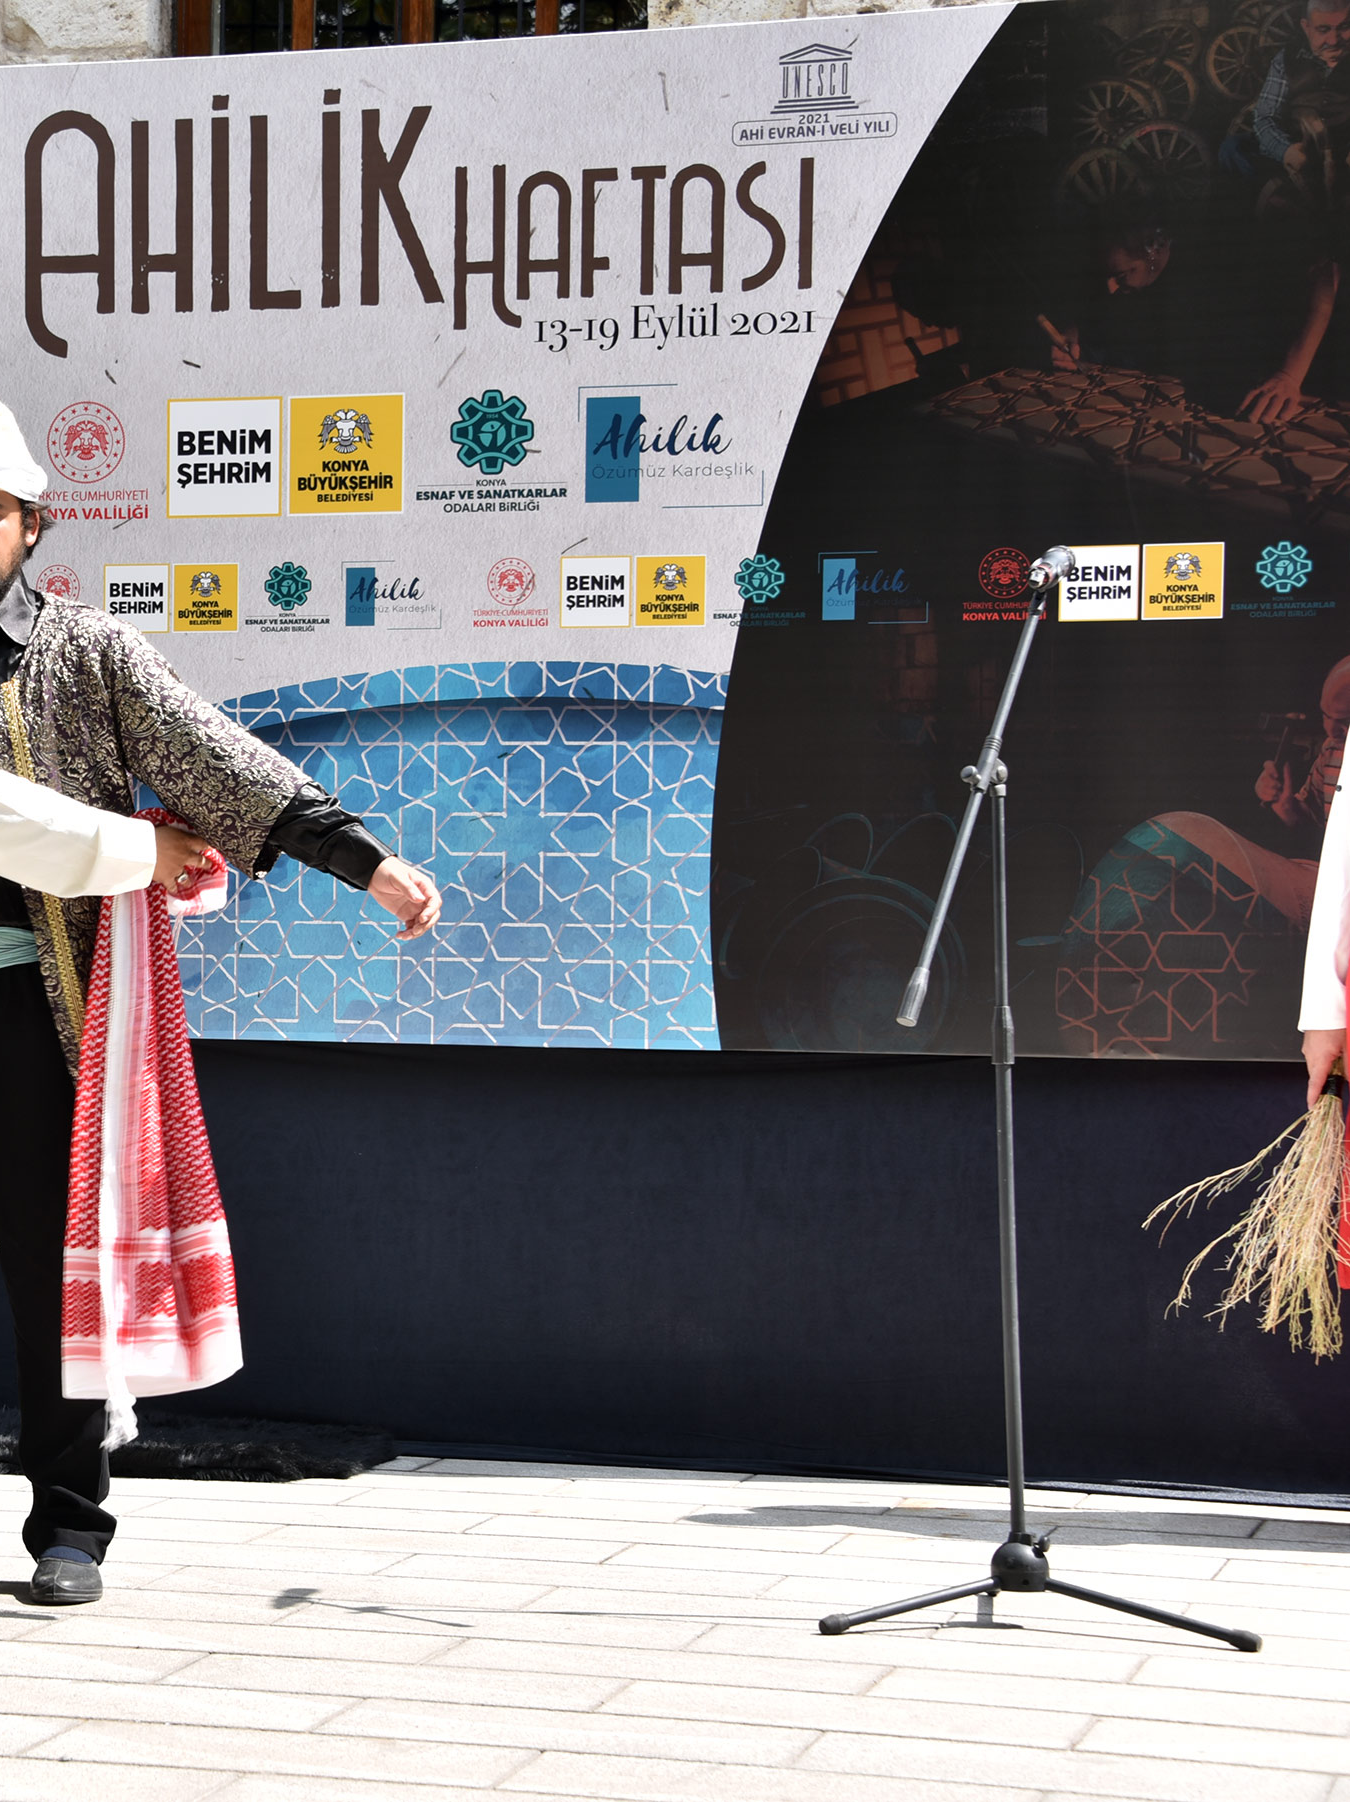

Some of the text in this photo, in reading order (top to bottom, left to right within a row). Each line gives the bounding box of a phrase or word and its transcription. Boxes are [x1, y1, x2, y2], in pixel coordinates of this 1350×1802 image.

[782, 62, 849, 99] UNESCO
[798, 113, 831, 125] 2021
[739, 125, 764, 142] AHİ
[829, 119, 859, 135] VELİ
[864, 120, 890, 133] YILI
[24, 88, 816, 358] AHİLİK HAFTASI
[533, 302, 817, 353] 13-19 Eylül 2021
[593, 413, 733, 460] Ahilik
[321, 459, 369, 474] KONYA
[591, 461, 755, 480] Özümüz Kardeşlik
[297, 474, 394, 492] BÜYÜKŞEHİR
[475, 479, 507, 487] KONYA
[39, 487, 149, 502] RKİYE CUMHURİYETİ
[317, 491, 374, 503] BELEDİYESİ
[416, 487, 568, 502] ESNAF VE SANATKARLAR
[47, 504, 149, 520] NYA VALİLİĞİ
[443, 502, 496, 514] ODALARI
[826, 567, 910, 596] Ahilik
[349, 576, 425, 603] Ahilik
[1166, 583, 1199, 593] KONYA
[654, 593, 685, 602] KONYA
[1148, 592, 1216, 605] BÜYÜKŞEHİR
[191, 600, 219, 608] KONYA
[392, 603, 437, 614] Kardeşlik
[639, 602, 700, 614] BÜYÜKŞEHİR
[994, 600, 1031, 610] CUMHUR
[1162, 603, 1202, 612] BELEDİYESİ
[177, 608, 233, 619] BÜYÜKŞEHİR
[651, 612, 688, 620] BELEDİYESİ
[713, 612, 738, 620] ESNAF
[962, 609, 1048, 621] KONYA VALİİ
[473, 617, 549, 628] KONYA VALİLİĞİ
